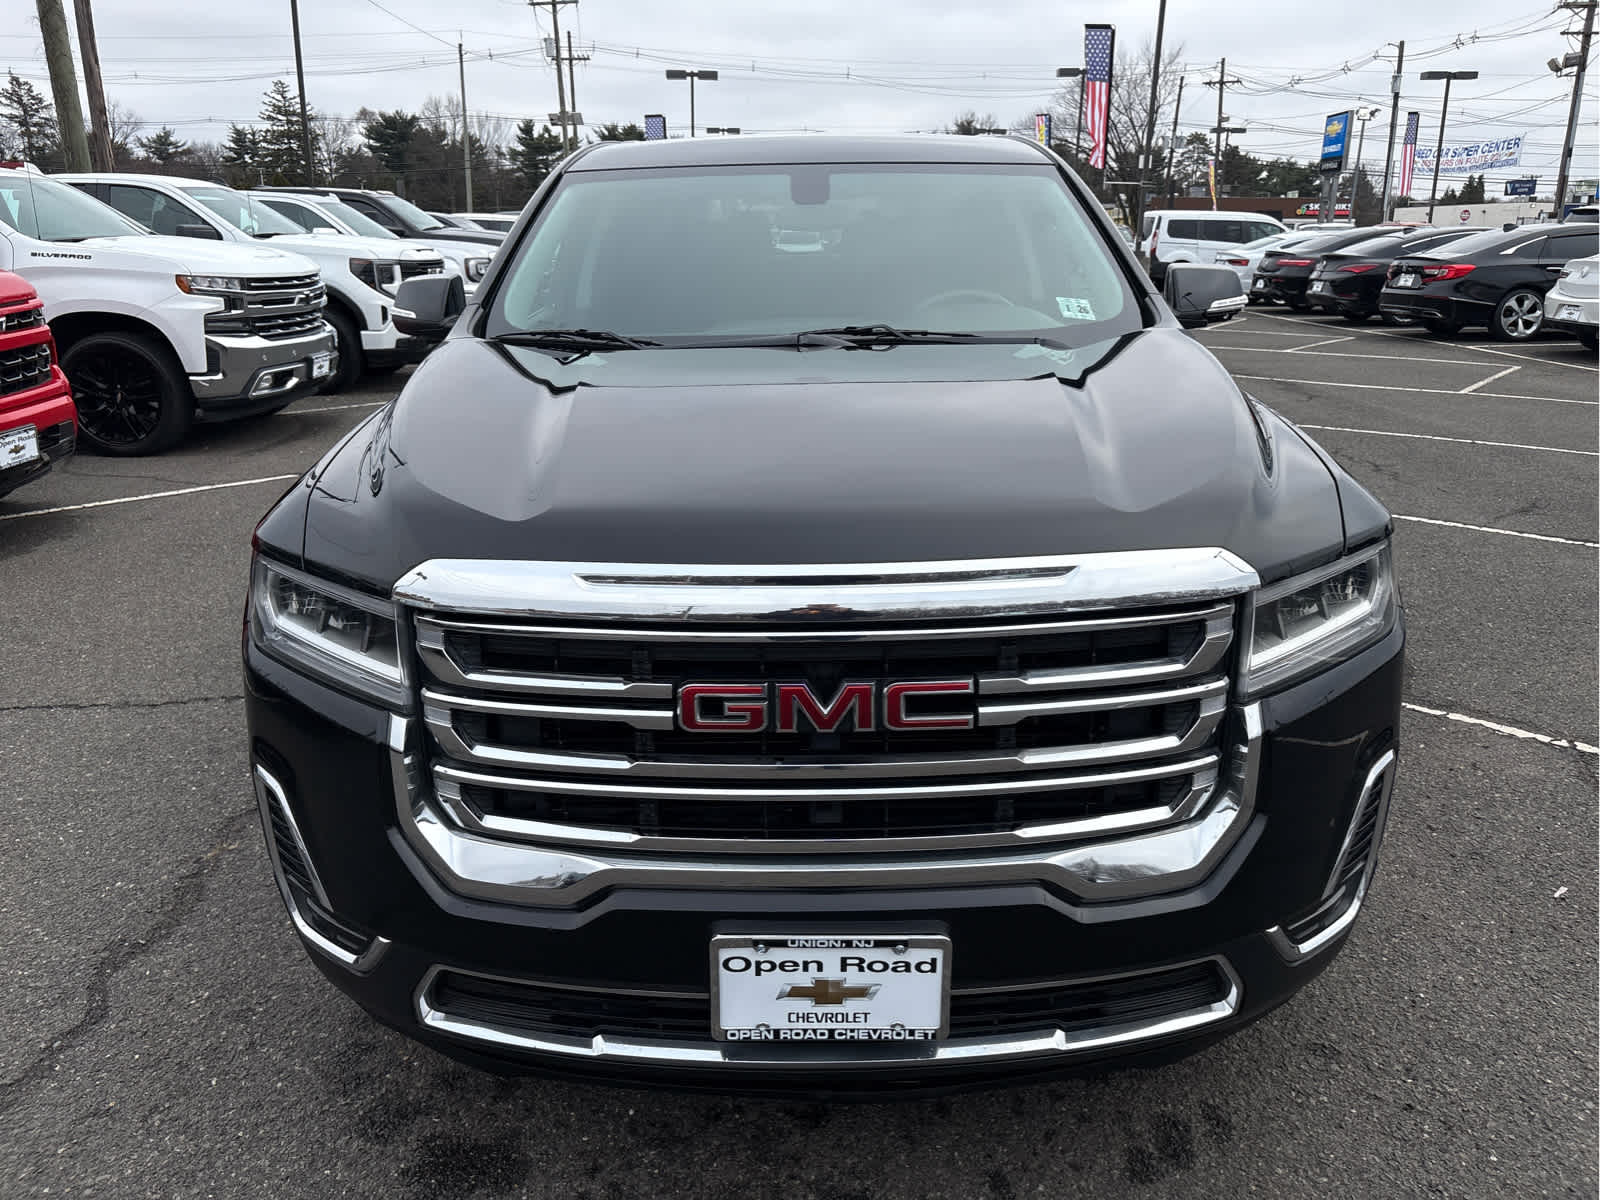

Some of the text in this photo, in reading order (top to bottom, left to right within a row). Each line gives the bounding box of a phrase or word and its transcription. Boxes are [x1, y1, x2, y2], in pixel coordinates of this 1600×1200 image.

[1481, 137, 1521, 154] CENTER
[30, 251, 92, 260] SILVERADO
[677, 679, 974, 733] GMC
[787, 939, 874, 948] UNION, NJ
[722, 956, 937, 976] Open Road
[787, 1012, 871, 1024] CHEVROLET
[726, 1029, 935, 1040] OPEN ROAD CHEVROLET
